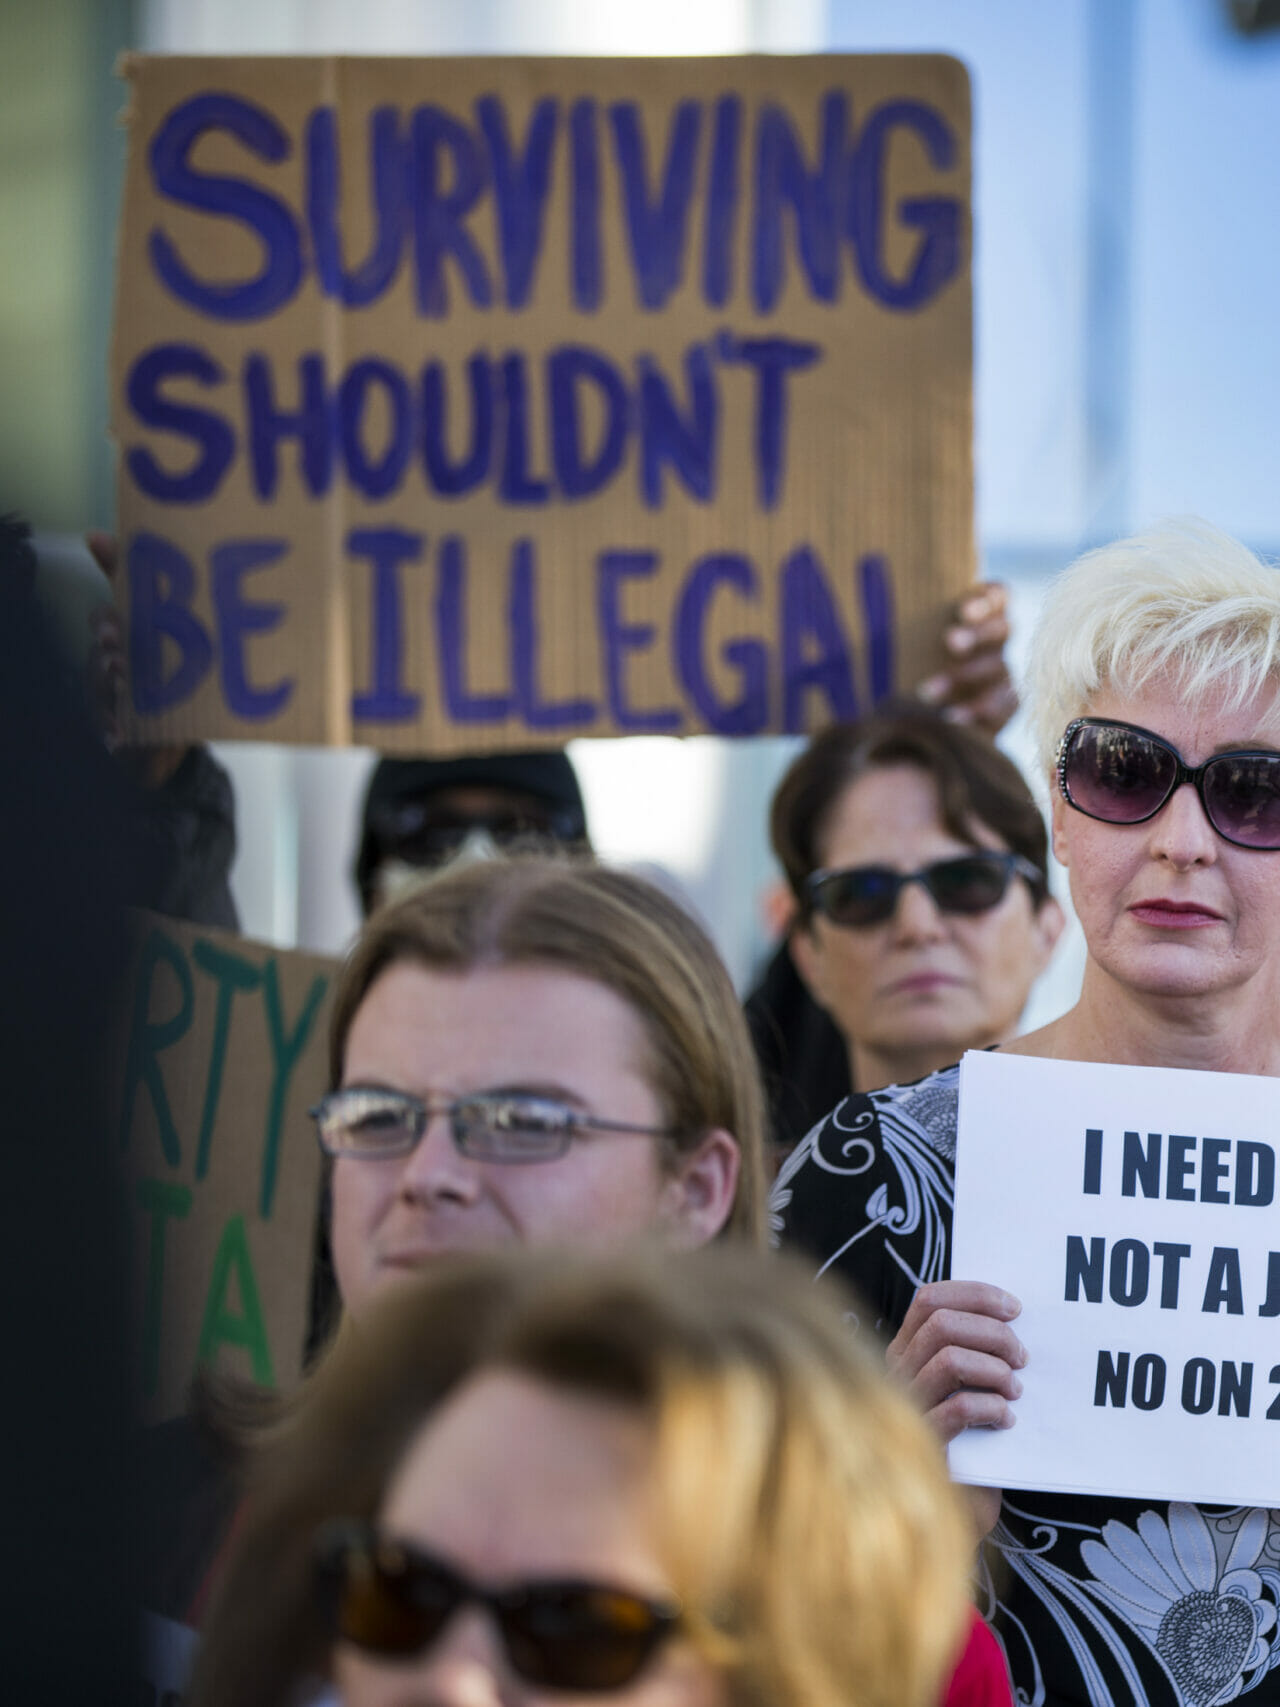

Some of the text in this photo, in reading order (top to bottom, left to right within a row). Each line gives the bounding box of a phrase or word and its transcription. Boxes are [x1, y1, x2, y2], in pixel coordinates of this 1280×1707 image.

[148, 88, 961, 324] SURVIVING
[125, 326, 822, 513] SHOULDN'T
[127, 531, 295, 722] BE
[1083, 1128, 1103, 1195] I
[1121, 1131, 1276, 1207] NEED
[1064, 1235, 1191, 1310] NOT
[1202, 1247, 1244, 1315] A
[1094, 1350, 1167, 1412] NO
[1182, 1358, 1254, 1419] ON
